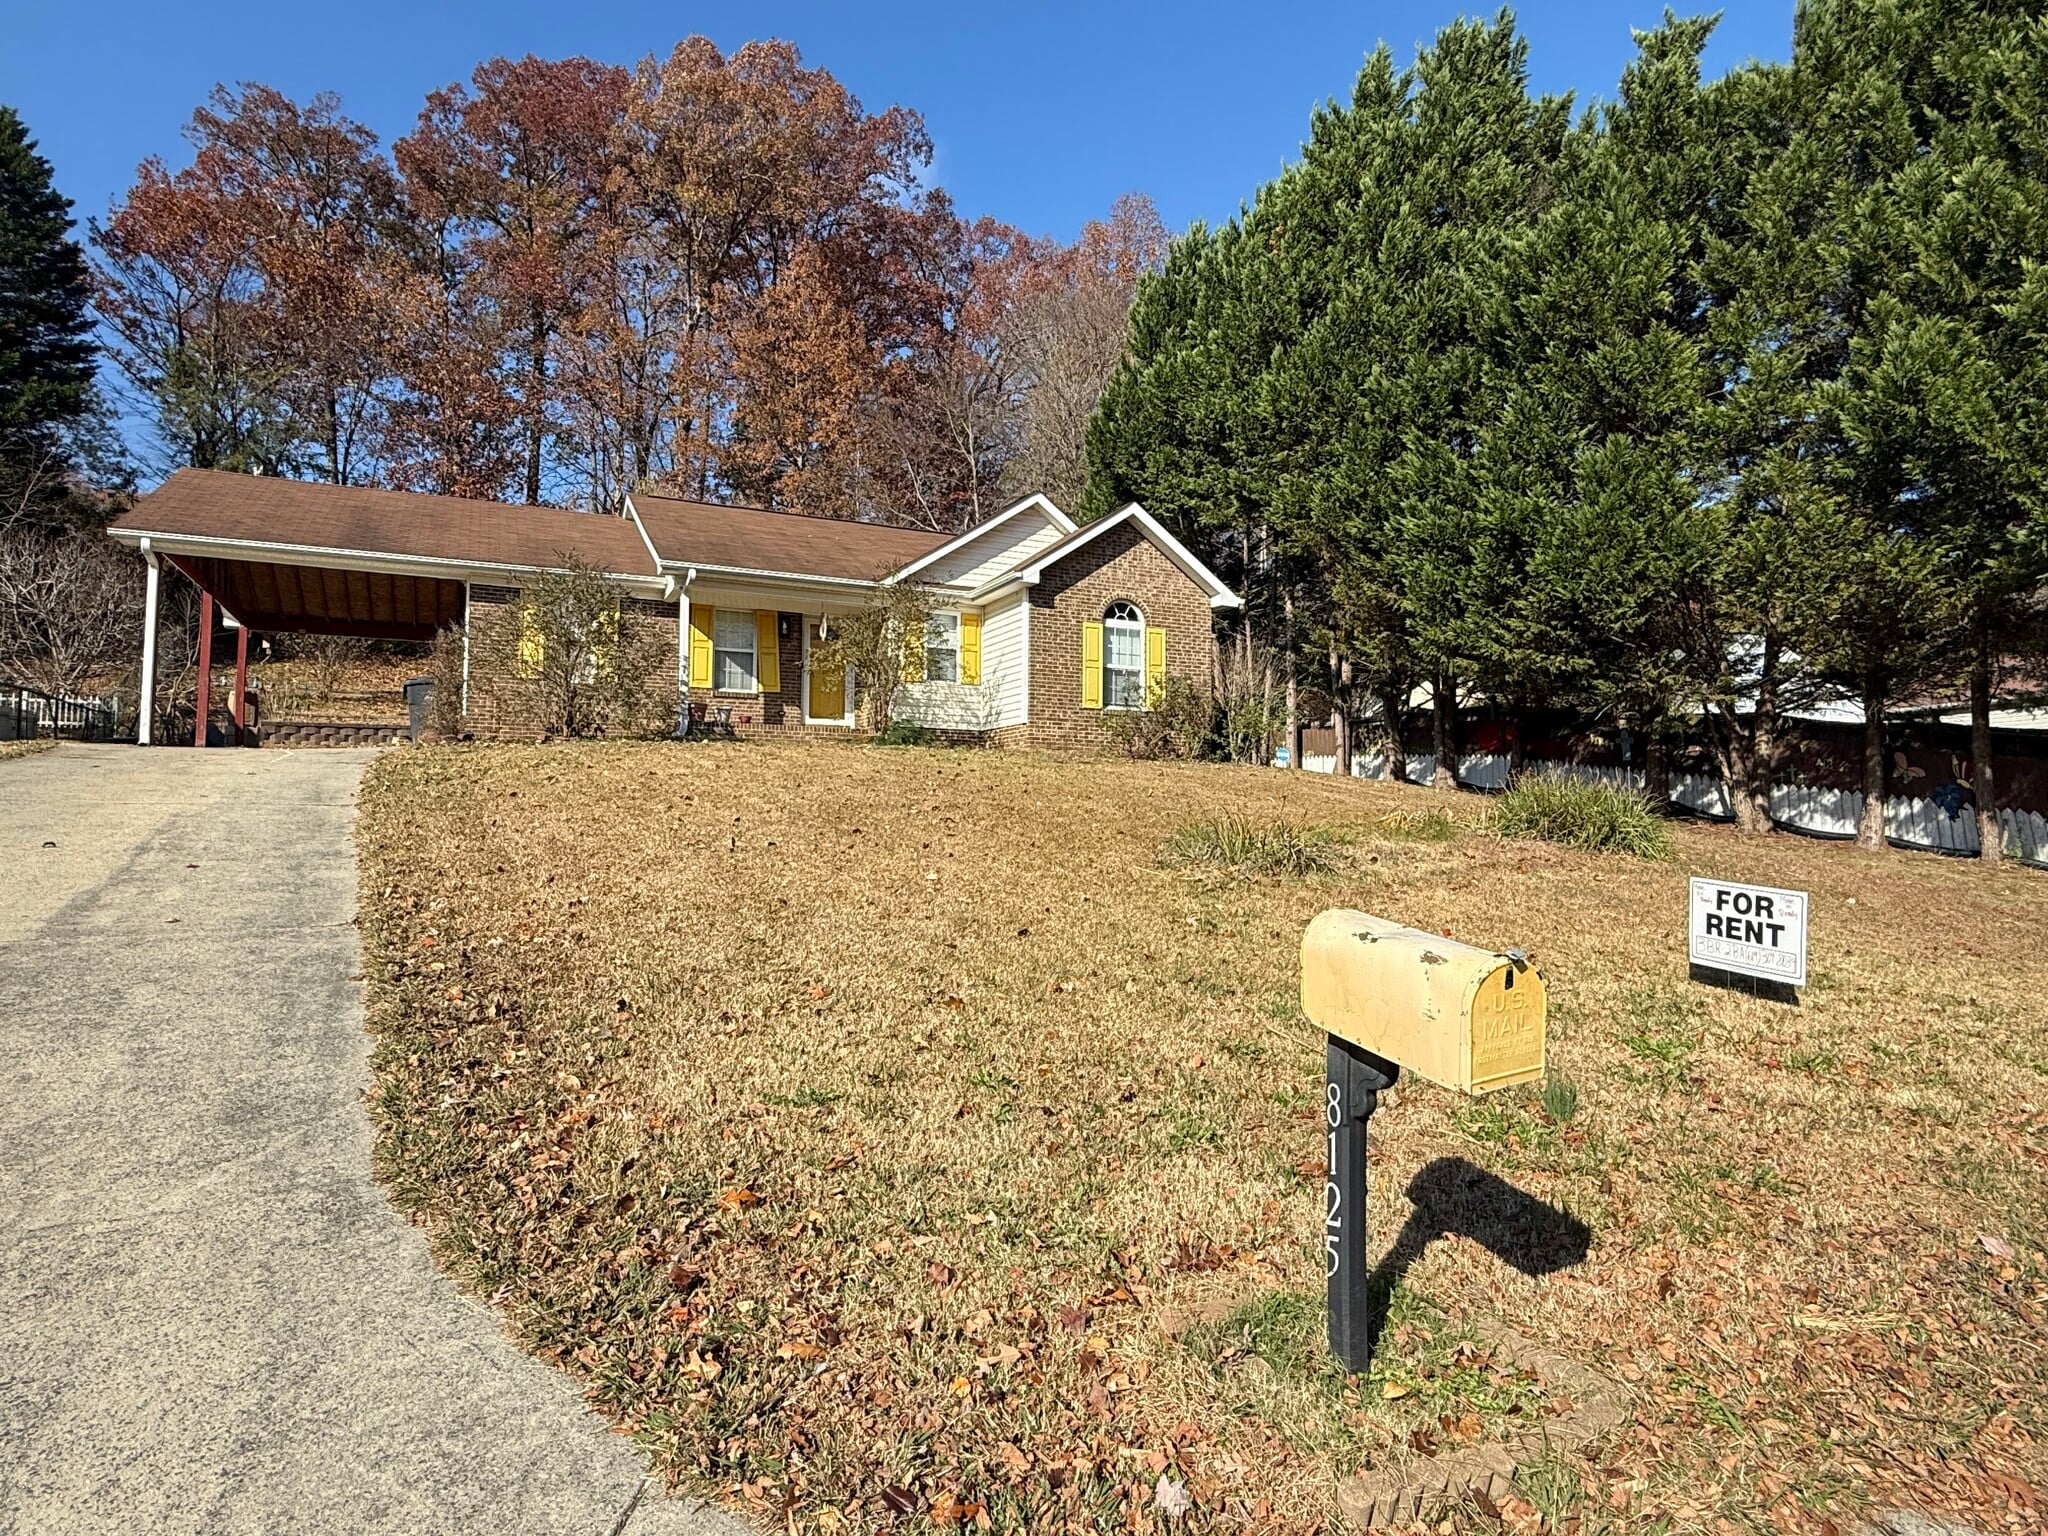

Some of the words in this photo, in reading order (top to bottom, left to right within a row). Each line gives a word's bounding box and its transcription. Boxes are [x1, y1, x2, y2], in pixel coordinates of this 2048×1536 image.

[1716, 890, 1774, 919] FOR
[1706, 913, 1785, 947] RENT
[1493, 991, 1529, 1014] U.S.
[1483, 1013, 1534, 1041] MAIL
[1325, 1082, 1342, 1279] 8125
